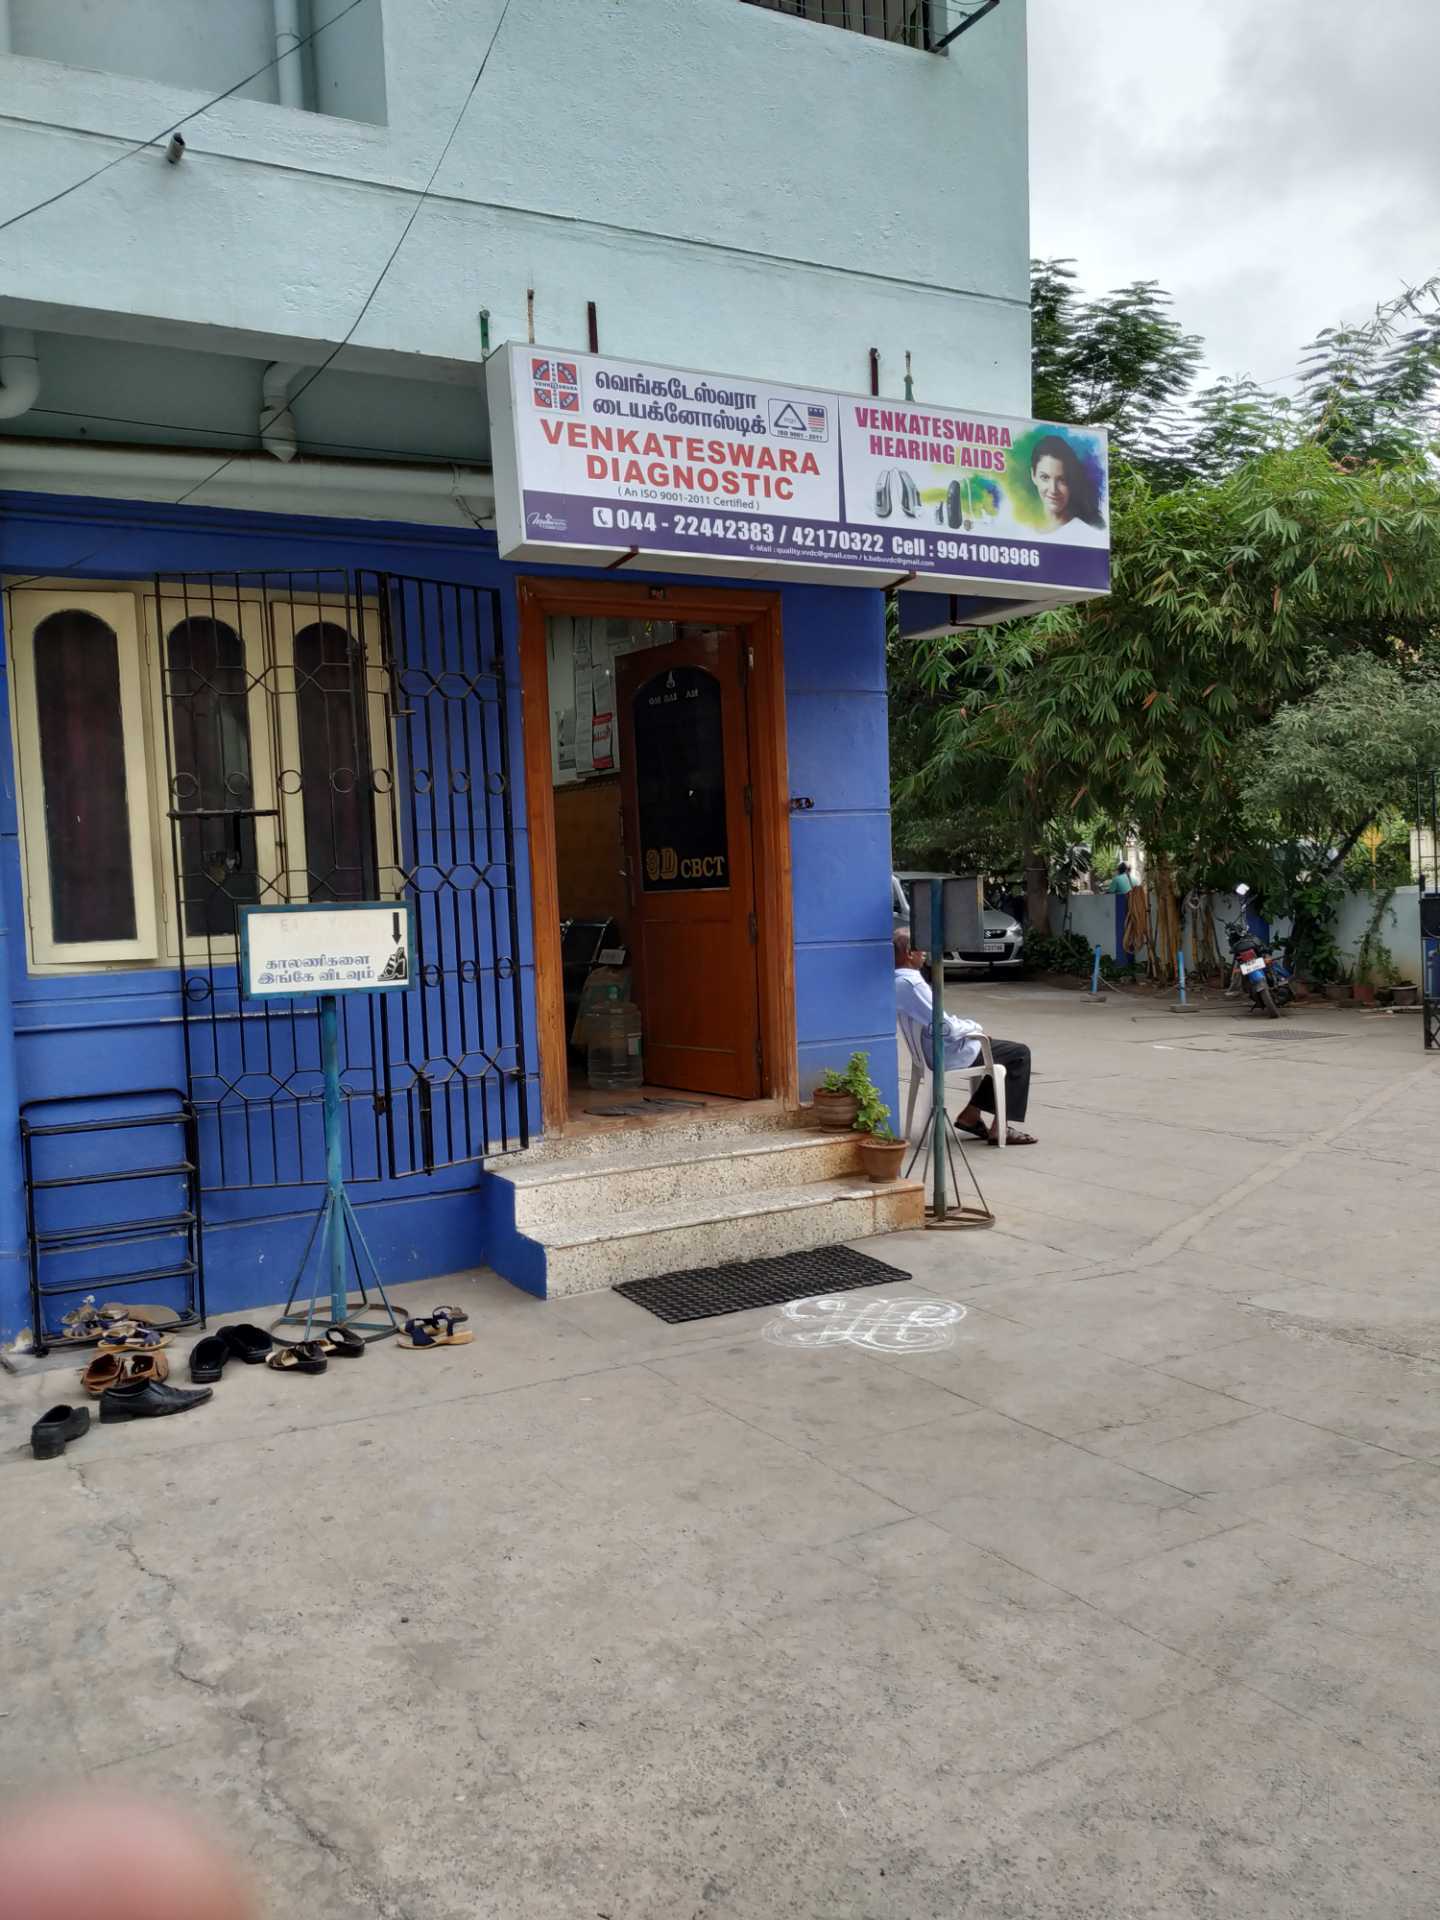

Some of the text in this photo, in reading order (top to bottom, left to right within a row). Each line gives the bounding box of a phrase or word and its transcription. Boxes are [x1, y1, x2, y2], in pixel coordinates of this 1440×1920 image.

[595, 370, 758, 410] வெங்கடேஸ்வரா
[593, 397, 767, 437] டையக்னோஸ்டிக்
[855, 406, 1013, 448] VENKATESWARA
[540, 418, 821, 476] VENKATESWARA
[869, 434, 1006, 472] HEARING AIDS
[586, 454, 794, 501] DIAGNOSTIC
[641, 489, 658, 499] ISO
[661, 490, 710, 505] 9001-2011
[713, 496, 754, 509] Certified
[616, 508, 657, 532] 044
[673, 514, 774, 543] 22442383
[792, 525, 884, 553] 42170322
[892, 535, 926, 557] Cell
[936, 539, 1041, 567] 9941003986
[680, 855, 726, 879] CBCT
[258, 966, 375, 985] இங்கே விடவும்
[264, 953, 370, 970] காலணிகளை
